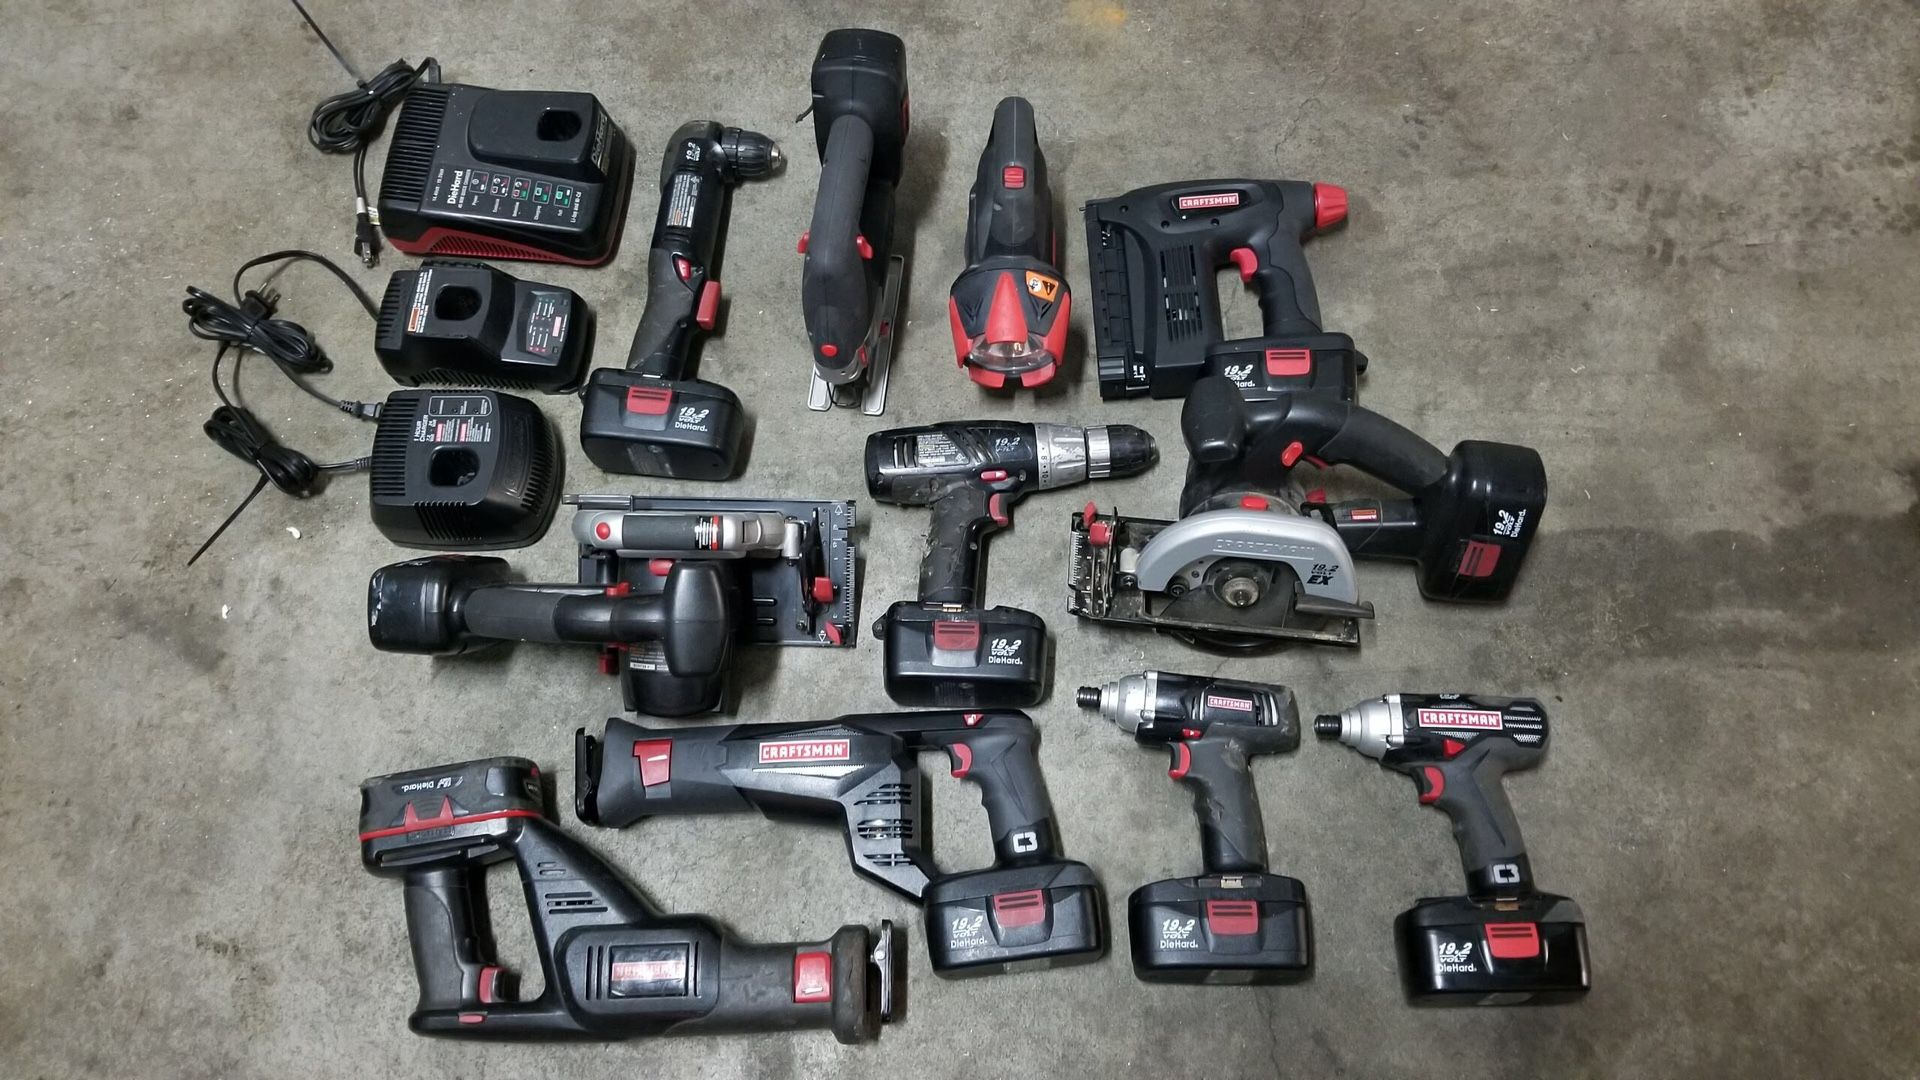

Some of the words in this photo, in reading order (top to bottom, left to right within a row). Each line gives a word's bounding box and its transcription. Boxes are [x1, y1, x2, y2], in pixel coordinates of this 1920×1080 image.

[686, 142, 696, 160] 19.2
[447, 170, 463, 204] DieHard
[1181, 196, 1236, 206] CRAFTSMAN
[1224, 364, 1253, 376] 19.2
[679, 406, 710, 418] 19.2
[420, 414, 429, 442] CHARGER
[995, 436, 1020, 446] 19.2
[1493, 509, 1509, 535] 19.2
[1306, 575, 1334, 585] EX
[991, 638, 1021, 649] 19.2
[1209, 698, 1251, 710] CRAFTSMAN
[1422, 712, 1498, 726] CRAFTSMAN
[762, 743, 844, 759] CRAFTSMAN
[952, 915, 983, 930] 19.2
[1163, 919, 1195, 931] 19.2
[953, 930, 978, 938] VOLT
[1439, 942, 1473, 955] 19.2
